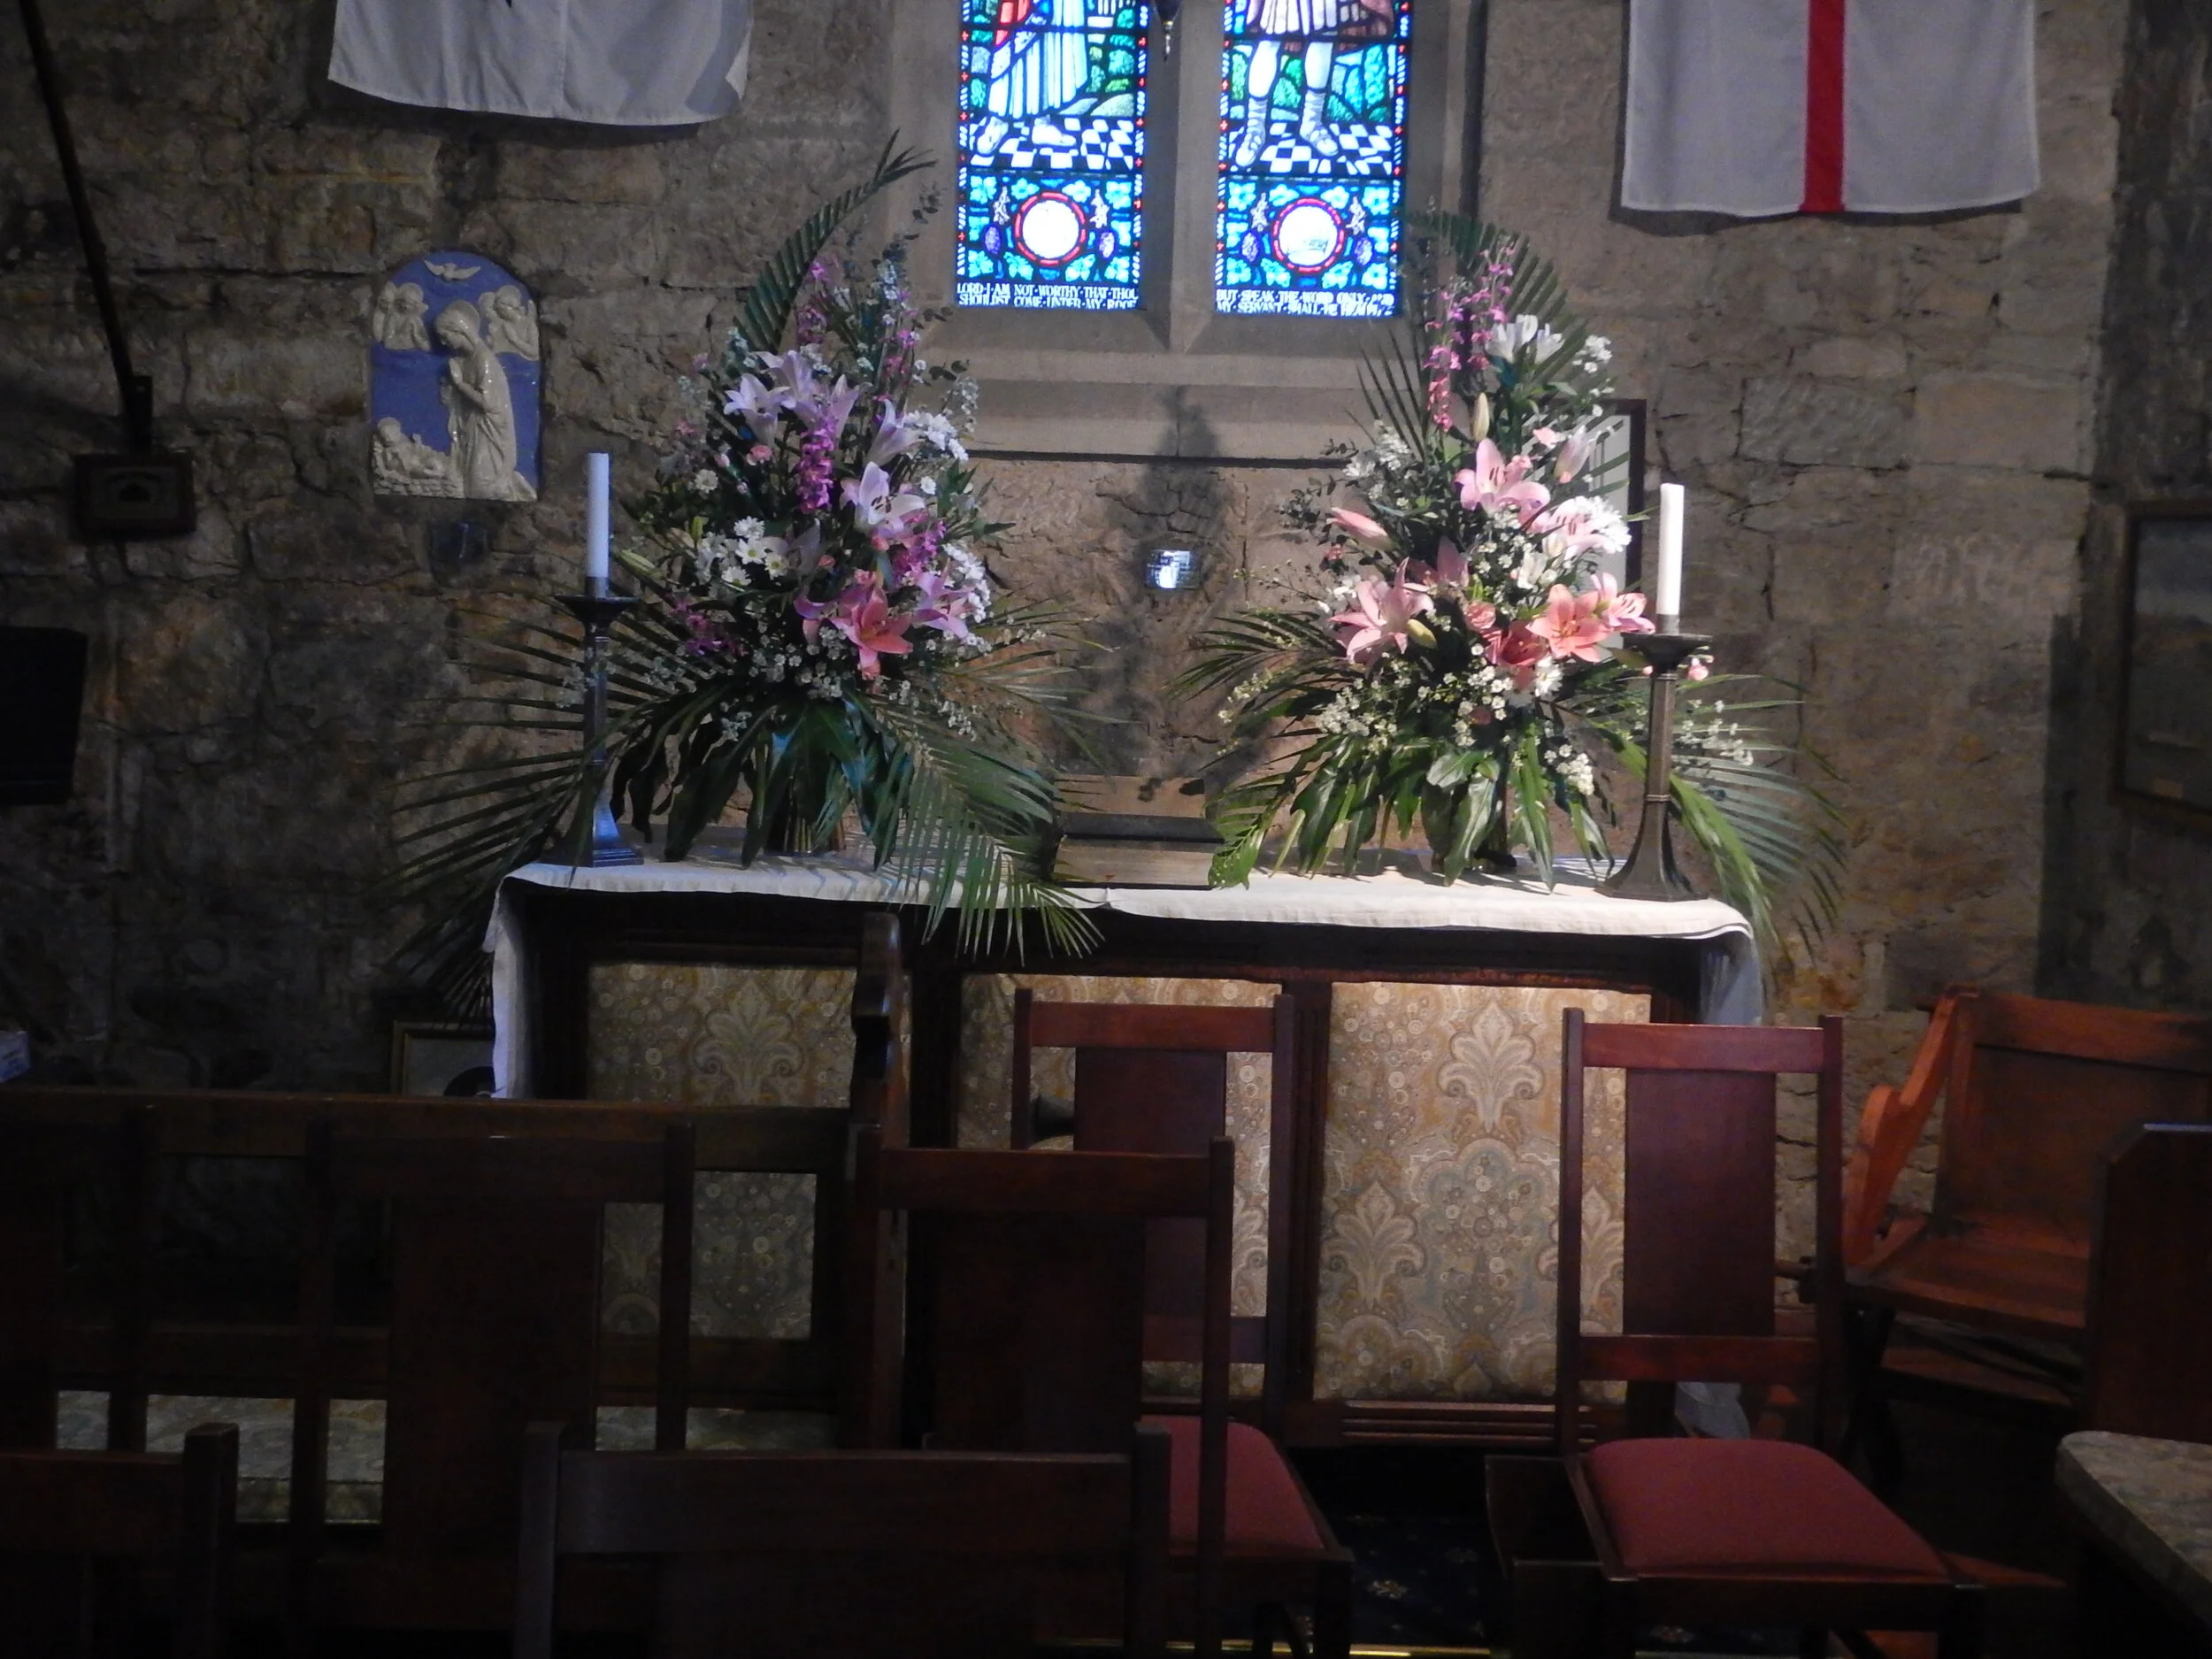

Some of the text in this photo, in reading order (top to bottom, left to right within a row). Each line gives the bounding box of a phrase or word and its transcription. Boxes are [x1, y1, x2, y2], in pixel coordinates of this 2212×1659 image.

[957, 283, 984, 294] LORD
[994, 283, 1010, 296] AM
[1014, 284, 1035, 297] NOT
[1038, 285, 1081, 299] WORTHY
[1084, 287, 1109, 300] THAT
[1217, 289, 1239, 302] BUT
[1278, 290, 1299, 303] THE
[1014, 296, 1043, 309] COME
[1086, 298, 1103, 310] MY
